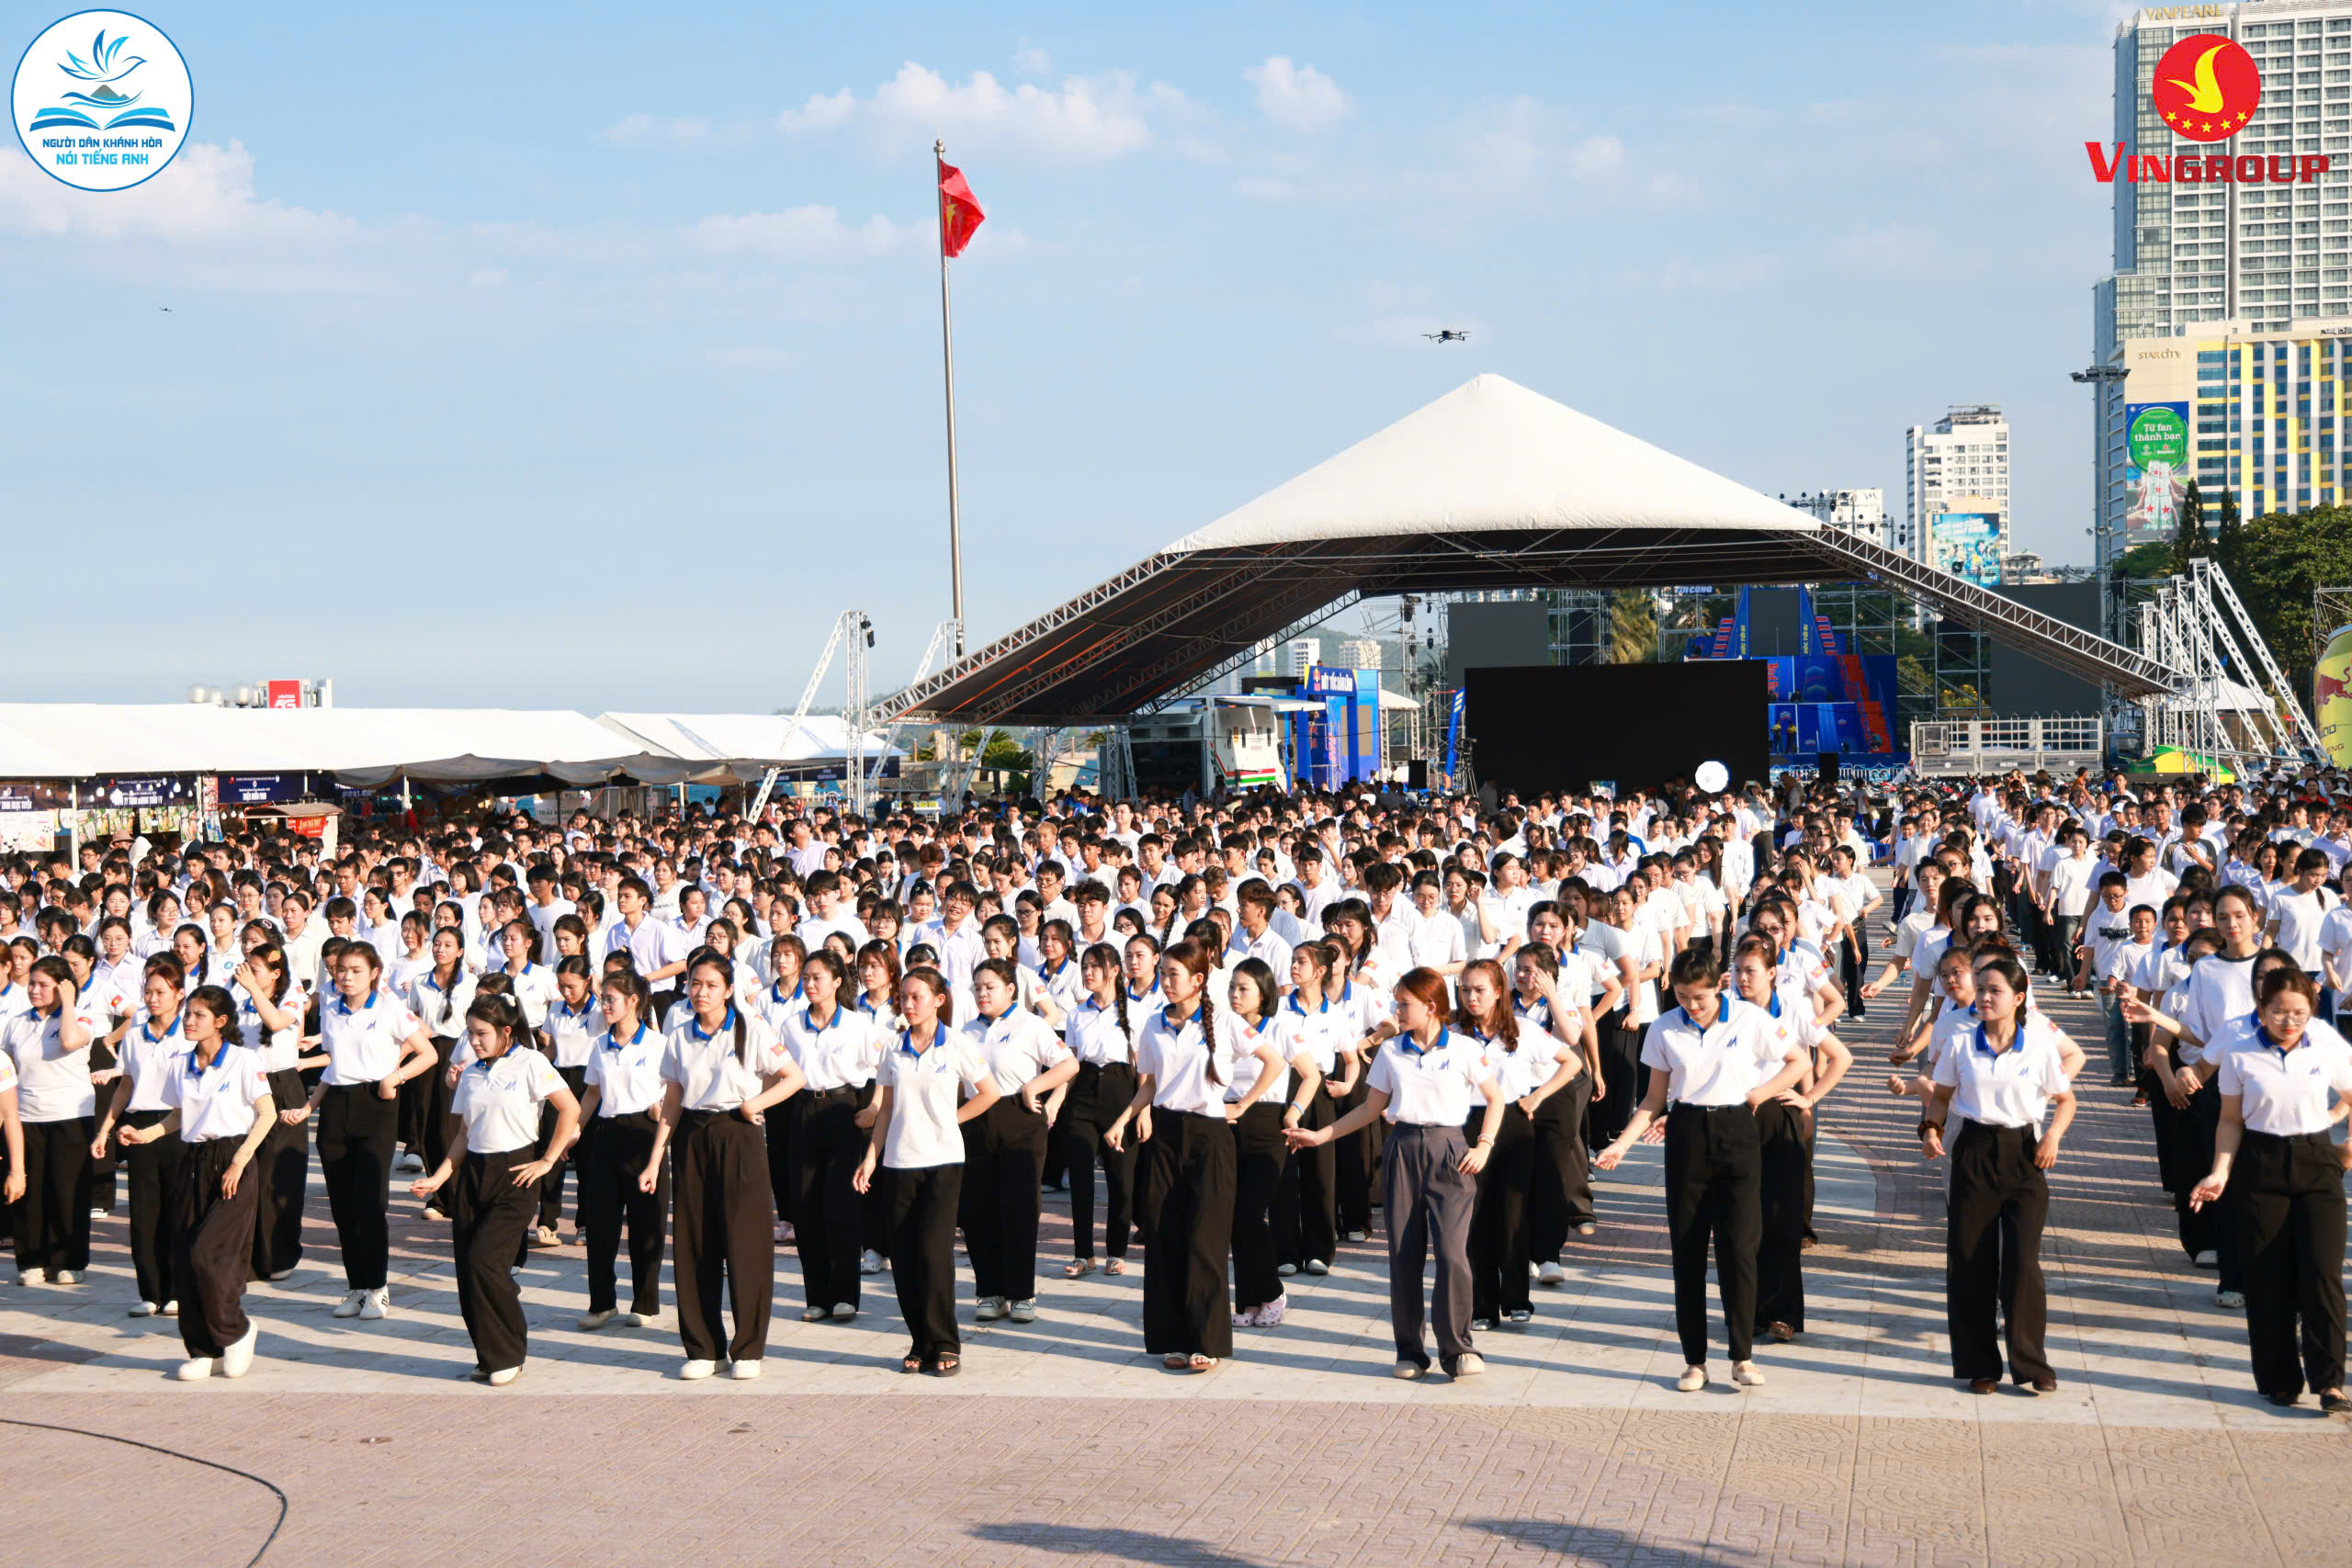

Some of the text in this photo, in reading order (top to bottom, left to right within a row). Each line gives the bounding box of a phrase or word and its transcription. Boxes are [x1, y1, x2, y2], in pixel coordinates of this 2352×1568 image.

[2145, 4, 2221, 21] VINPEARL
[2157, 423, 2172, 432] fan
[2164, 433, 2181, 442] bạn
